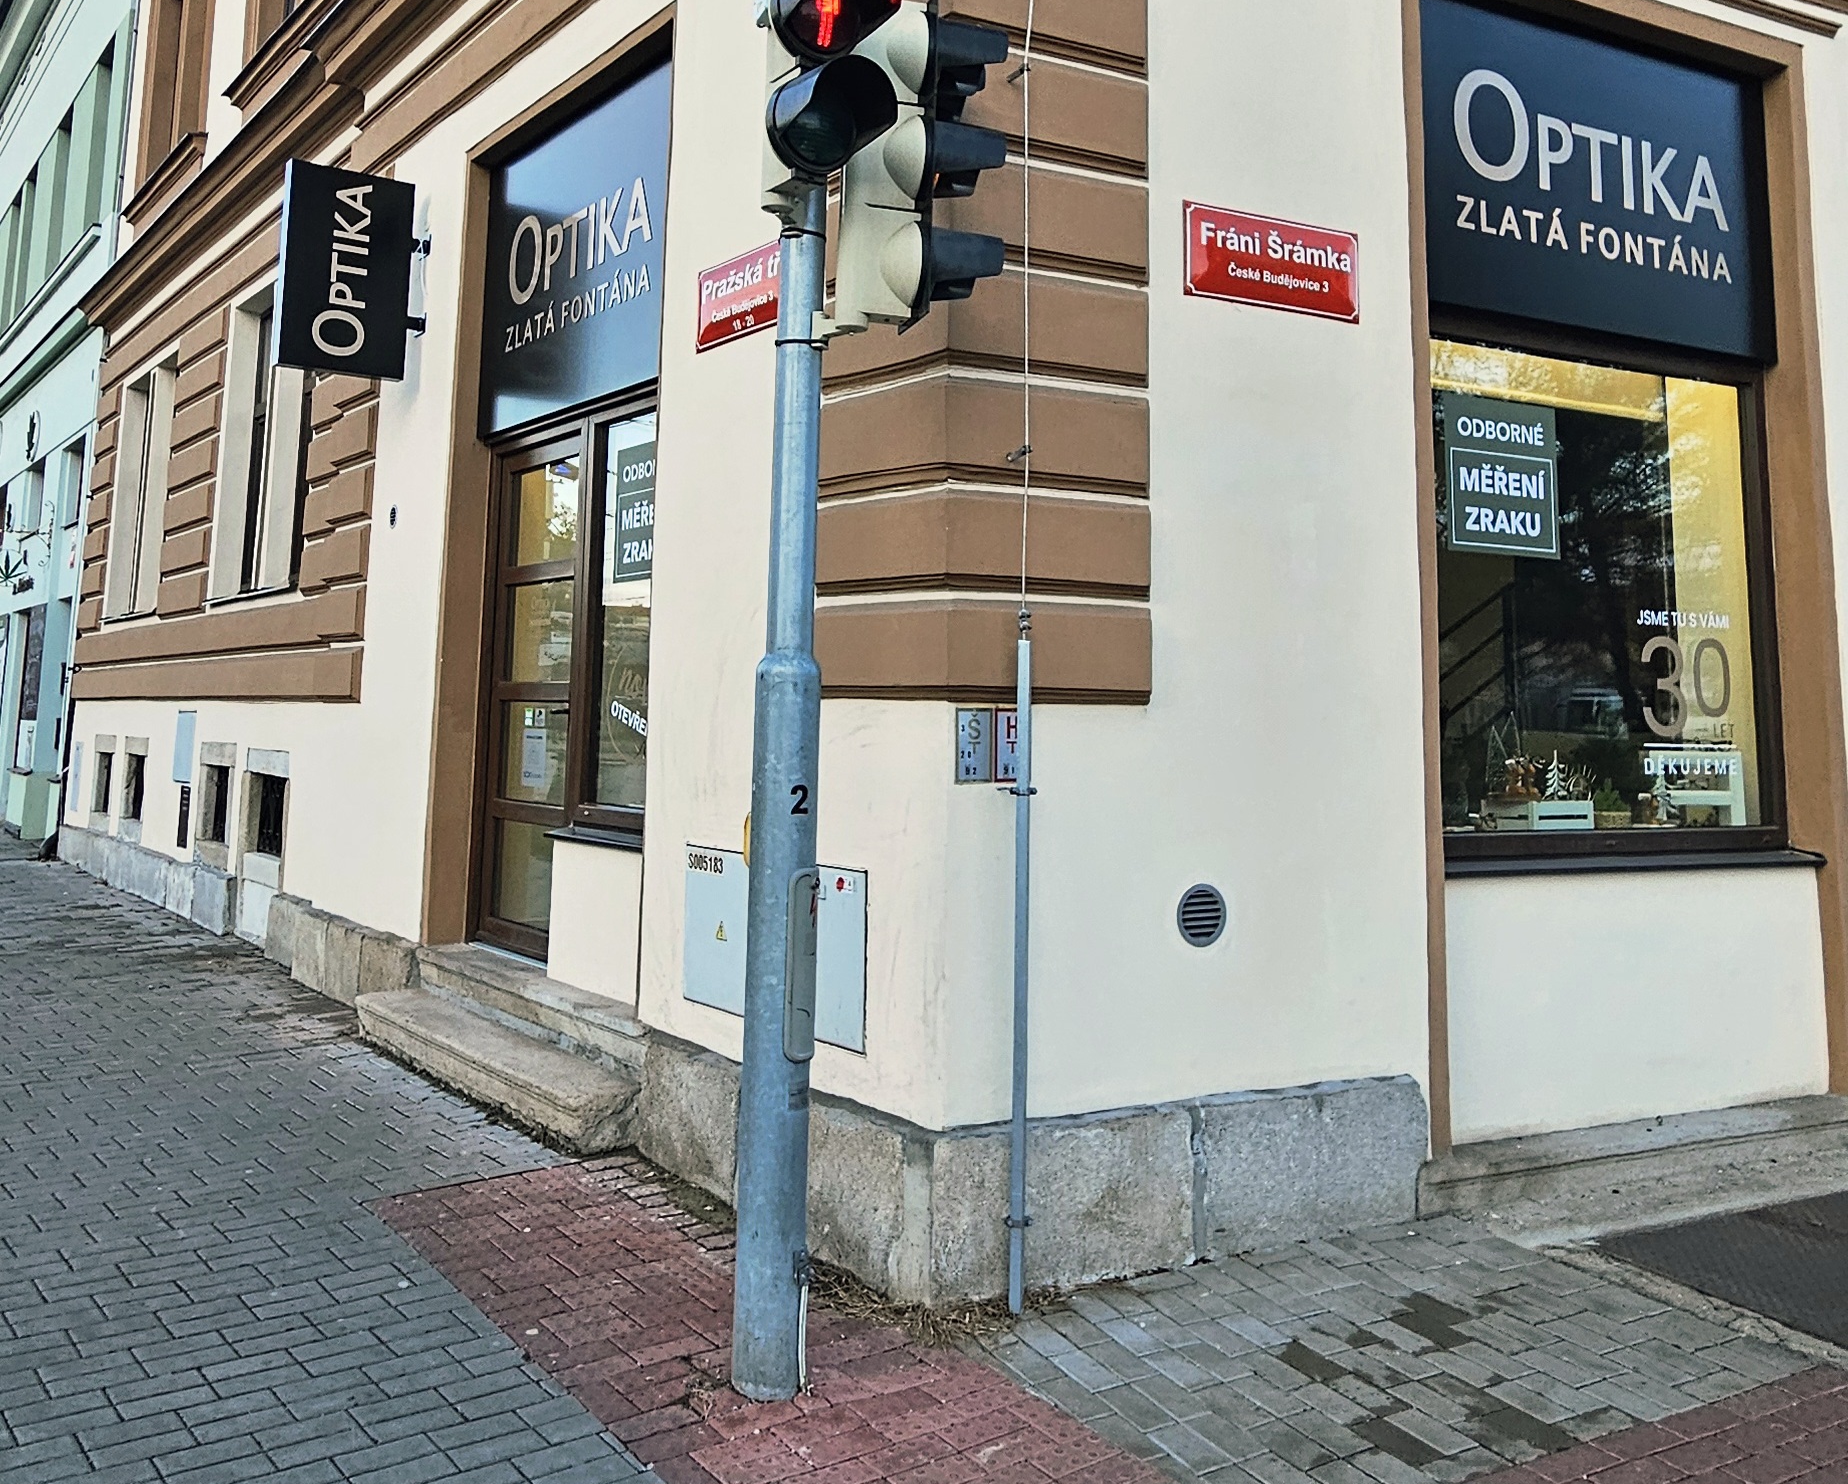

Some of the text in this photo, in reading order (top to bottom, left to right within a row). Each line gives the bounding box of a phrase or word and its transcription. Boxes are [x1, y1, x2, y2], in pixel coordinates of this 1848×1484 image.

[1200, 221, 1352, 273] Fráni Šrámka
[1455, 194, 1732, 284] ZLATÁ FONTÁNA
[702, 257, 763, 305] Pražská
[1228, 261, 1330, 294] České Budějovice 3
[504, 264, 651, 353] ZLATÁ FONTÁNA
[768, 289, 774, 301] 3
[1457, 416, 1545, 447] ODBORNÉ
[622, 458, 655, 483] ODBO
[1459, 463, 1546, 500] MĚŘENÍ
[1465, 506, 1541, 538] ZRAKU
[1636, 609, 1730, 629] JSME TU S VÁMI
[1641, 635, 1731, 737] 30
[1713, 723, 1735, 738] LET
[1644, 754, 1738, 776] DĚKUJEME
[790, 784, 809, 815] 2
